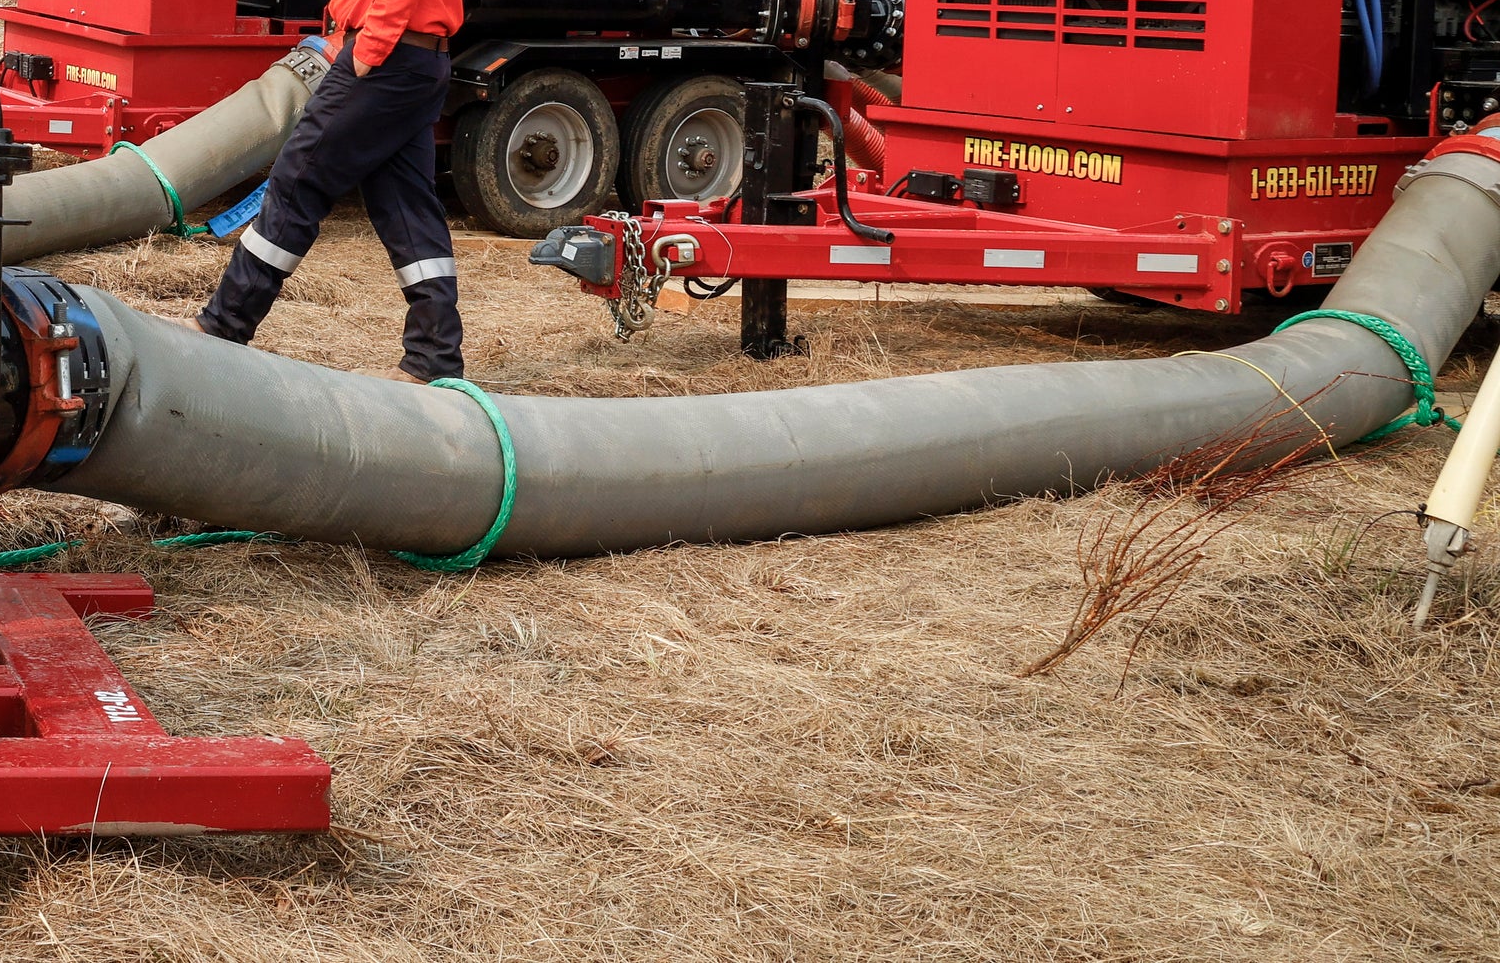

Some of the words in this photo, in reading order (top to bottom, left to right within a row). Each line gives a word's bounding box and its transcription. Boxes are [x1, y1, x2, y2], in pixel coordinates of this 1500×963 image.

[66, 63, 117, 92] FIRE-FLOOD.COM
[963, 136, 1122, 184] FIRE-FLOOD.COM
[1250, 164, 1378, 200] 1-833-611-3337
